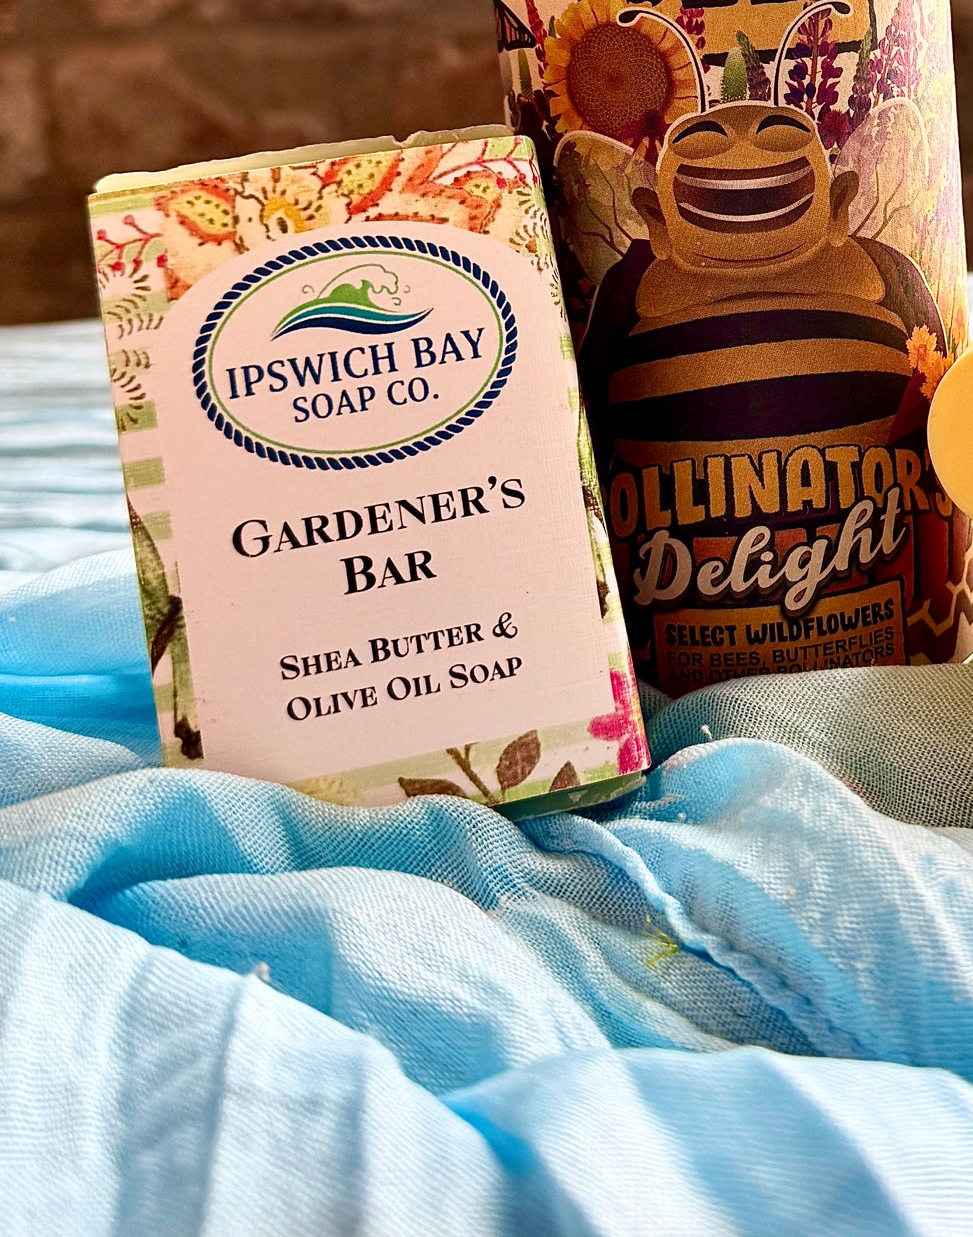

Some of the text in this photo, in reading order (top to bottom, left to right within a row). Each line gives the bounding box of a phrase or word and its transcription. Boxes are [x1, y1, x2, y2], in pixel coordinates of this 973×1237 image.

[226, 327, 485, 400] IPSWICH BAY
[293, 376, 440, 423] SOAP CO.
[232, 476, 527, 558] GARDENER'S
[340, 549, 438, 596] BAR
[634, 487, 905, 611] Delight
[280, 612, 518, 681] SHEA BUTTER &
[665, 598, 894, 647] SELECT WILDFLOWERS
[667, 626, 894, 669] FOR BEES, BUTTERFLIES
[286, 657, 523, 722] OLIVE OIL SOAP
[670, 668, 703, 684] AND
